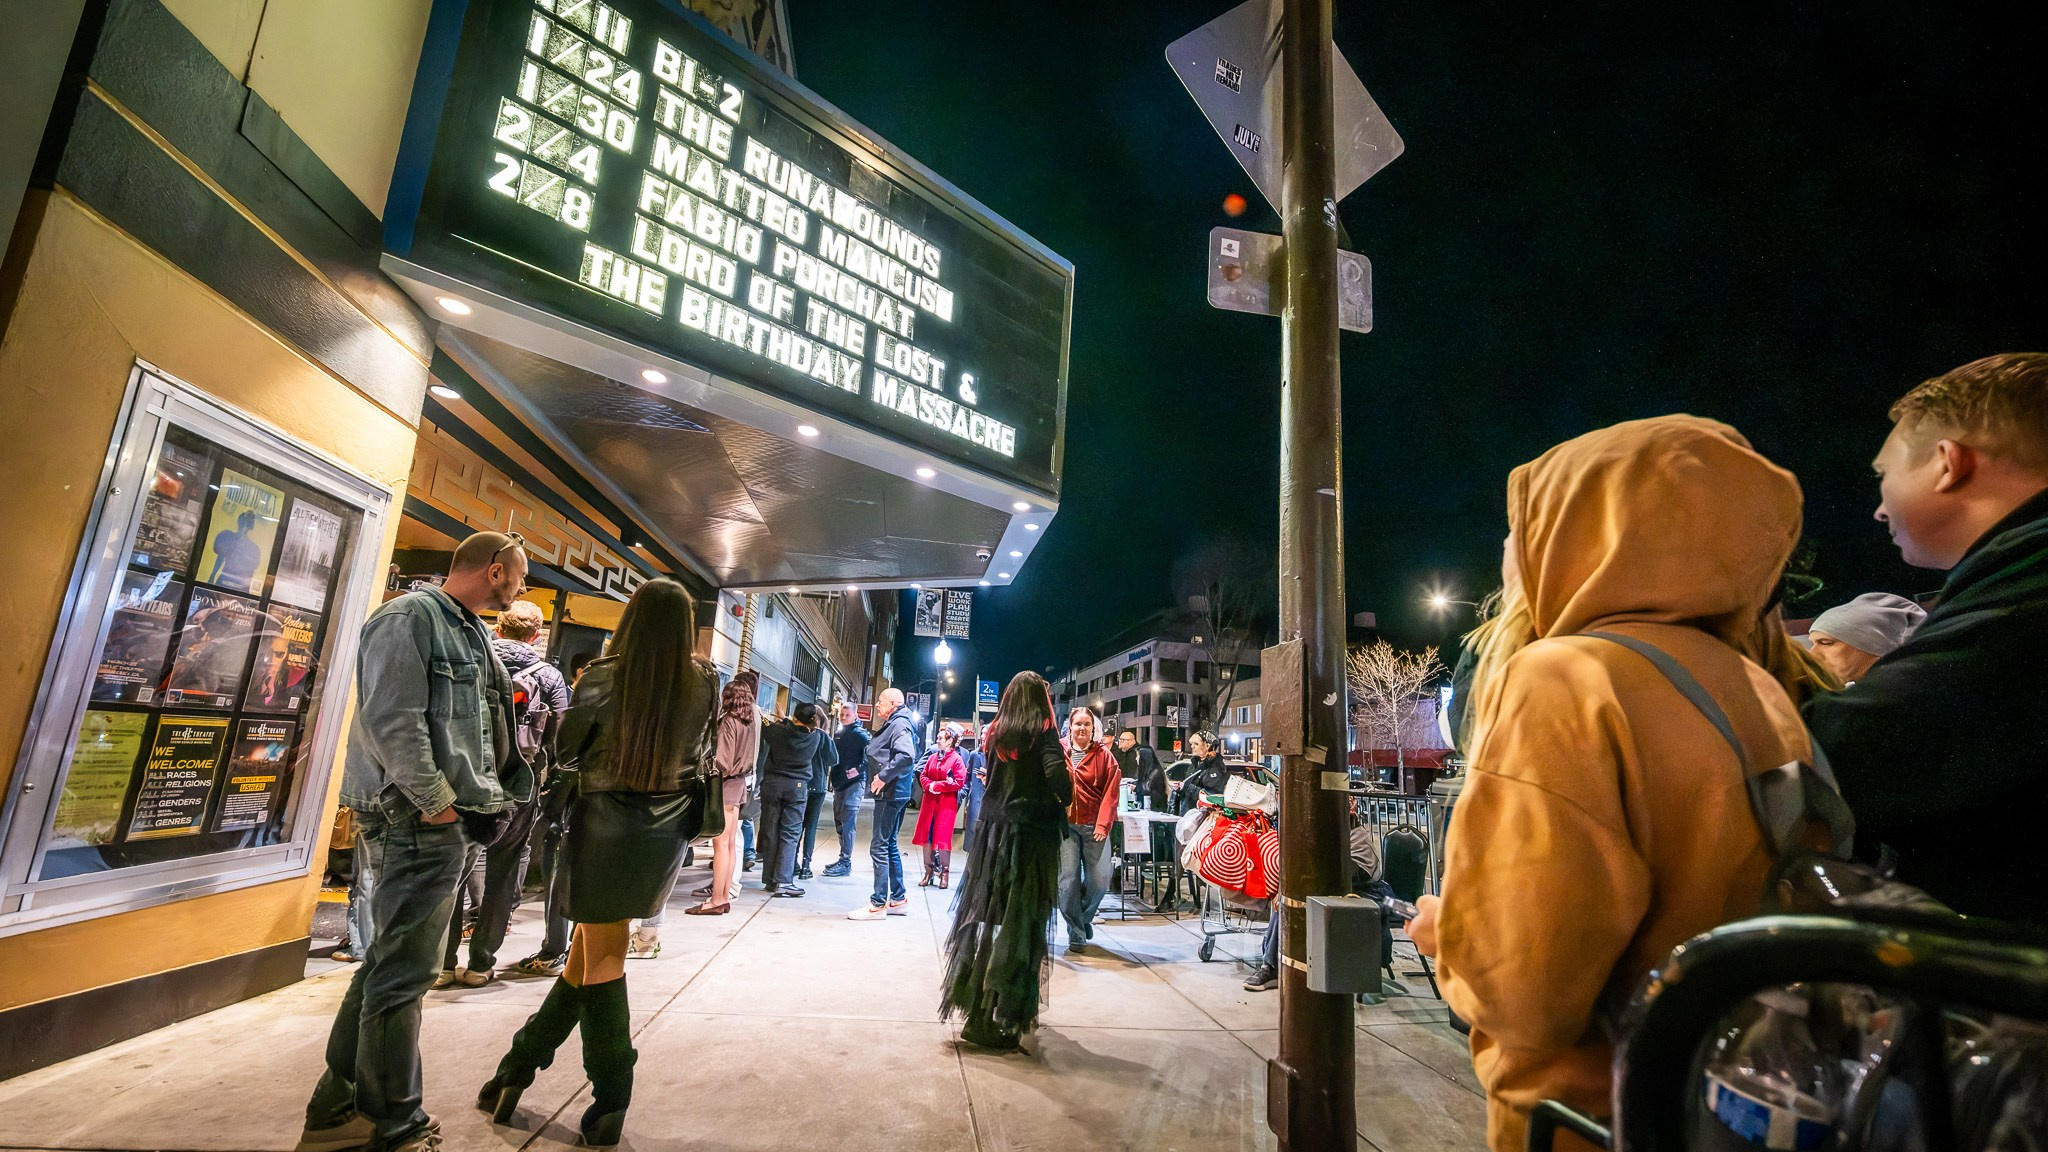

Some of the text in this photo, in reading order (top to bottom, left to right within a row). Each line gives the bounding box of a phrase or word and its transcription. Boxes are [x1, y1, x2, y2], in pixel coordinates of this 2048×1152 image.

[535, 0, 628, 55] /11
[531, 17, 743, 122] 1/24 BI-2
[521, 62, 636, 153] 1/30
[658, 87, 732, 161] THE
[1234, 126, 1257, 151] JULY
[495, 104, 600, 185] 2/4
[652, 135, 808, 245] MATTEO
[488, 153, 915, 338] 2/8 FABIO PORCHAT
[632, 217, 977, 405] LORD OF THE LOST &
[581, 244, 1016, 458] THE BIRTHDAY MASSACRE
[949, 591, 971, 599] LIVE
[283, 626, 313, 643] WATERS
[155, 746, 176, 756] WE
[149, 759, 214, 769] WELCOME
[165, 780, 212, 788] RELIGIONS
[158, 798, 202, 807] GENDERS
[155, 817, 192, 827] GENRES
